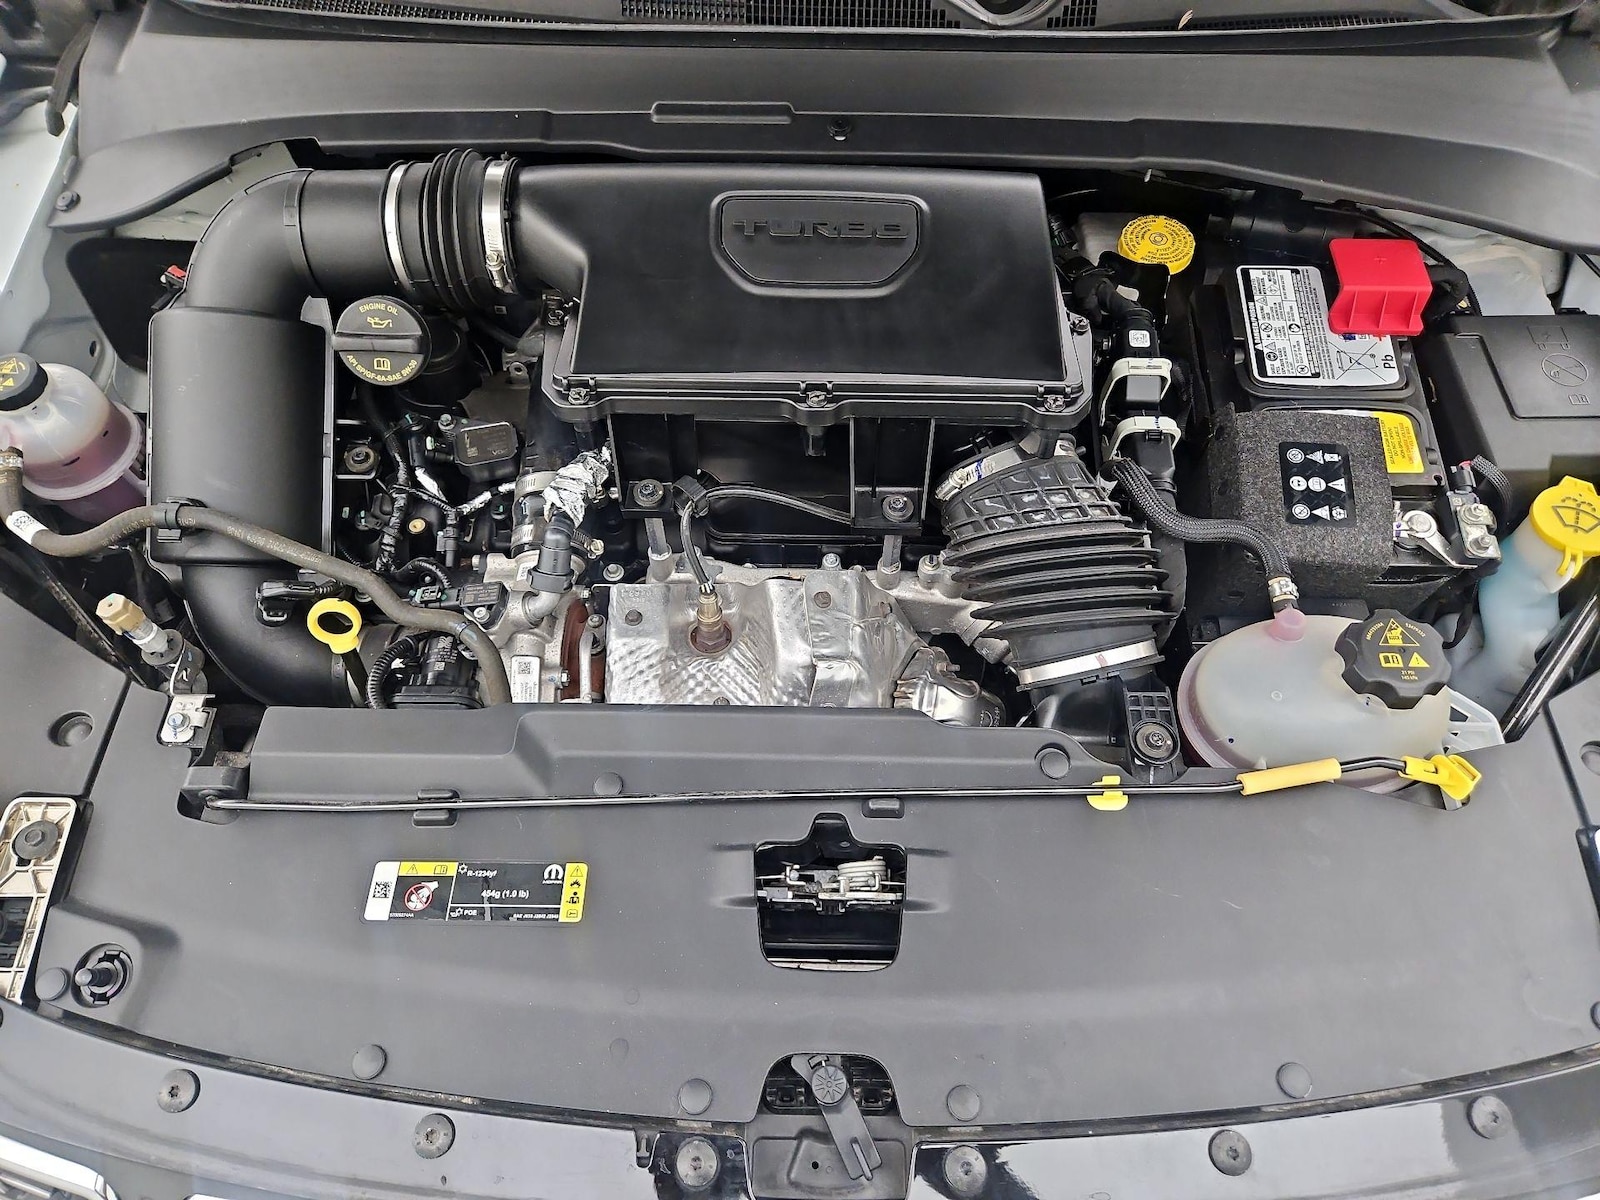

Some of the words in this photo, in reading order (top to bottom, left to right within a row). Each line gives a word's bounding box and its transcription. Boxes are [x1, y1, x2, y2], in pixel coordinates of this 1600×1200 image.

[732, 218, 909, 241] TURBO
[358, 303, 386, 314] ENGINE
[387, 306, 399, 316] OIL
[346, 354, 358, 368] API
[1381, 354, 1396, 369] Pb
[467, 869, 497, 879] R-1234yf
[481, 889, 501, 899] 454g
[502, 889, 517, 899] (1.0
[518, 889, 530, 899] lb)
[463, 909, 477, 917] POE
